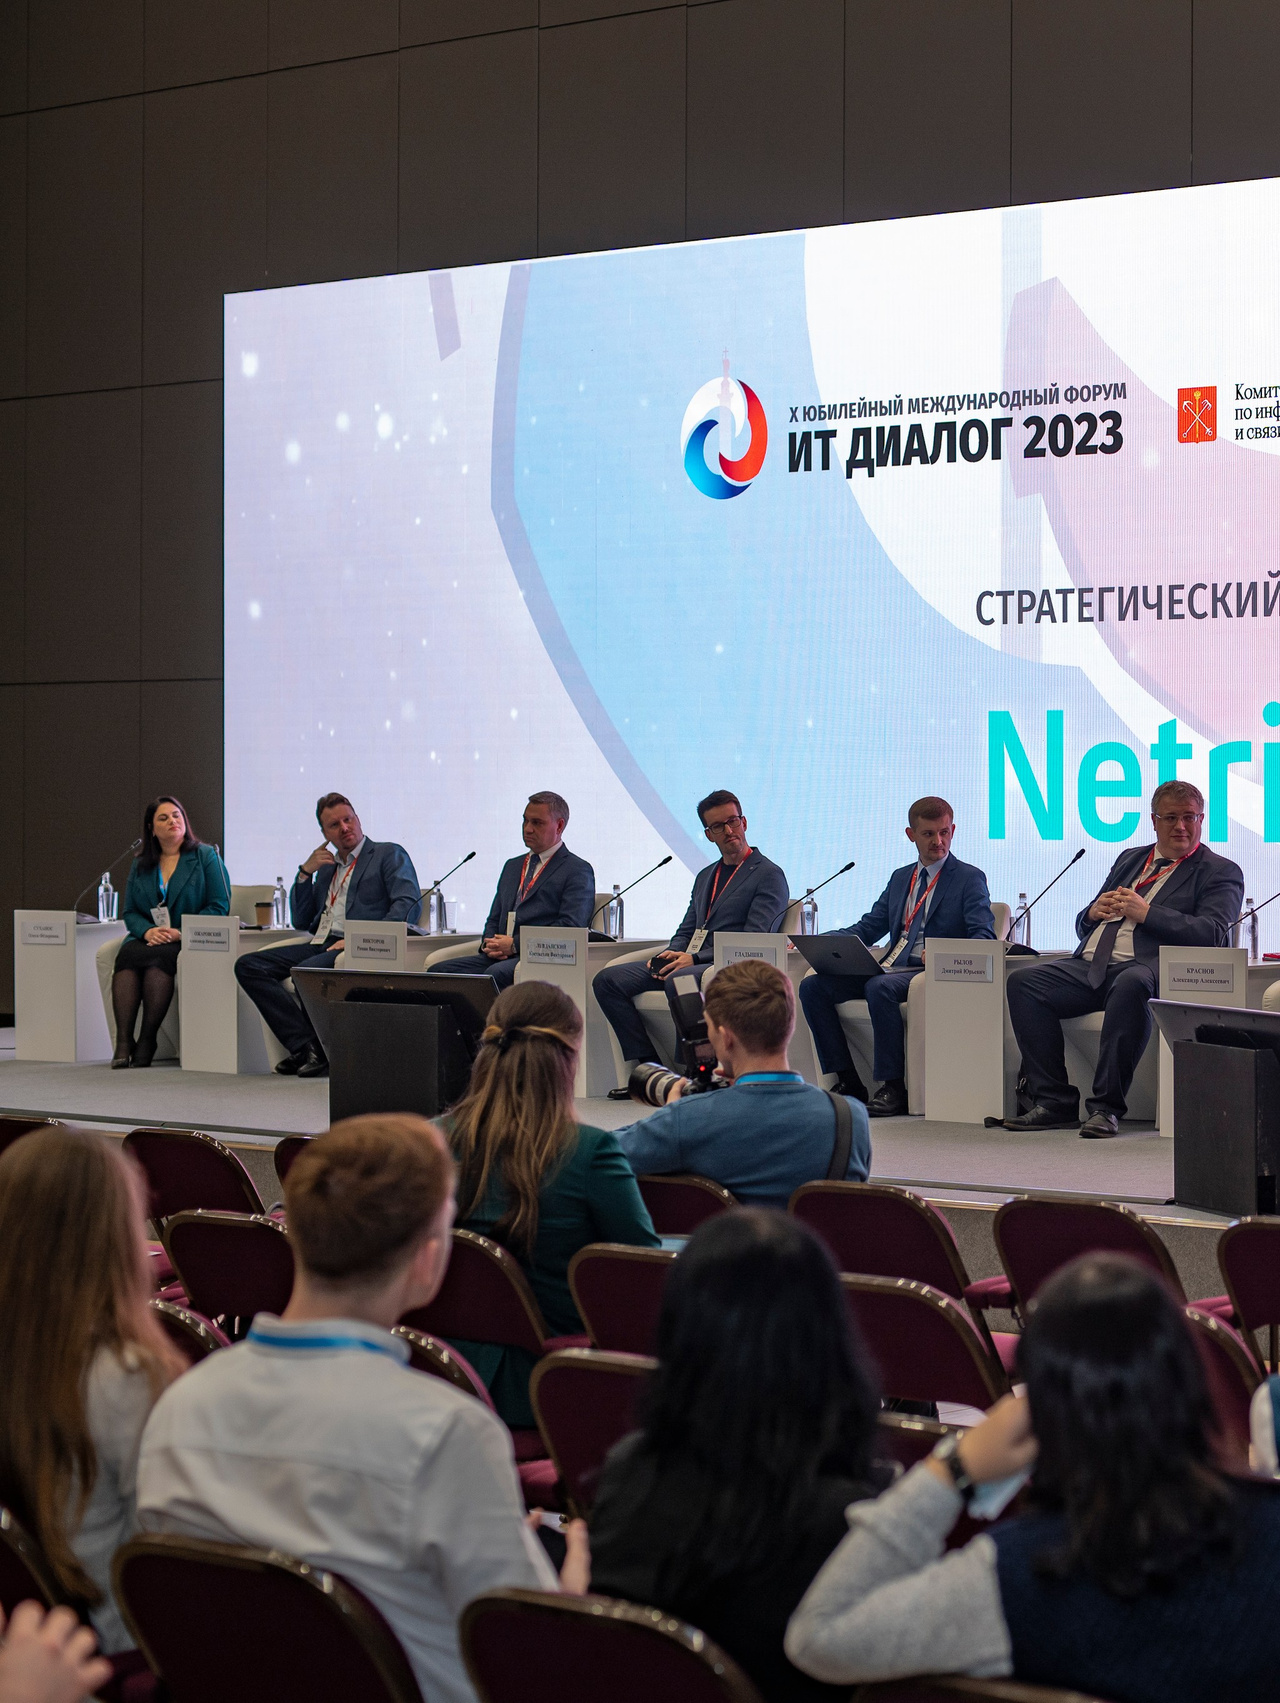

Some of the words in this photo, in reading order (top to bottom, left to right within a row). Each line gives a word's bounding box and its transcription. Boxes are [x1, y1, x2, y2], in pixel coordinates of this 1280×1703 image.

[802, 394, 904, 422] ЮБИЛЕЙНЫЙ
[908, 382, 1060, 415] МЕЖДУНАРОДНЫЙ
[1063, 382, 1127, 404] ФОРУМ
[1234, 407, 1252, 421] по
[1234, 428, 1244, 440] и
[788, 429, 838, 473] ИТ
[846, 417, 1014, 479] ДИАЛОГ
[1022, 410, 1124, 459] 2023
[941, 967, 963, 975] Дмитрий
[963, 968, 986, 976] Юрьевич
[1186, 967, 1215, 975] КРАСНОВ
[1171, 977, 1200, 985] Александр
